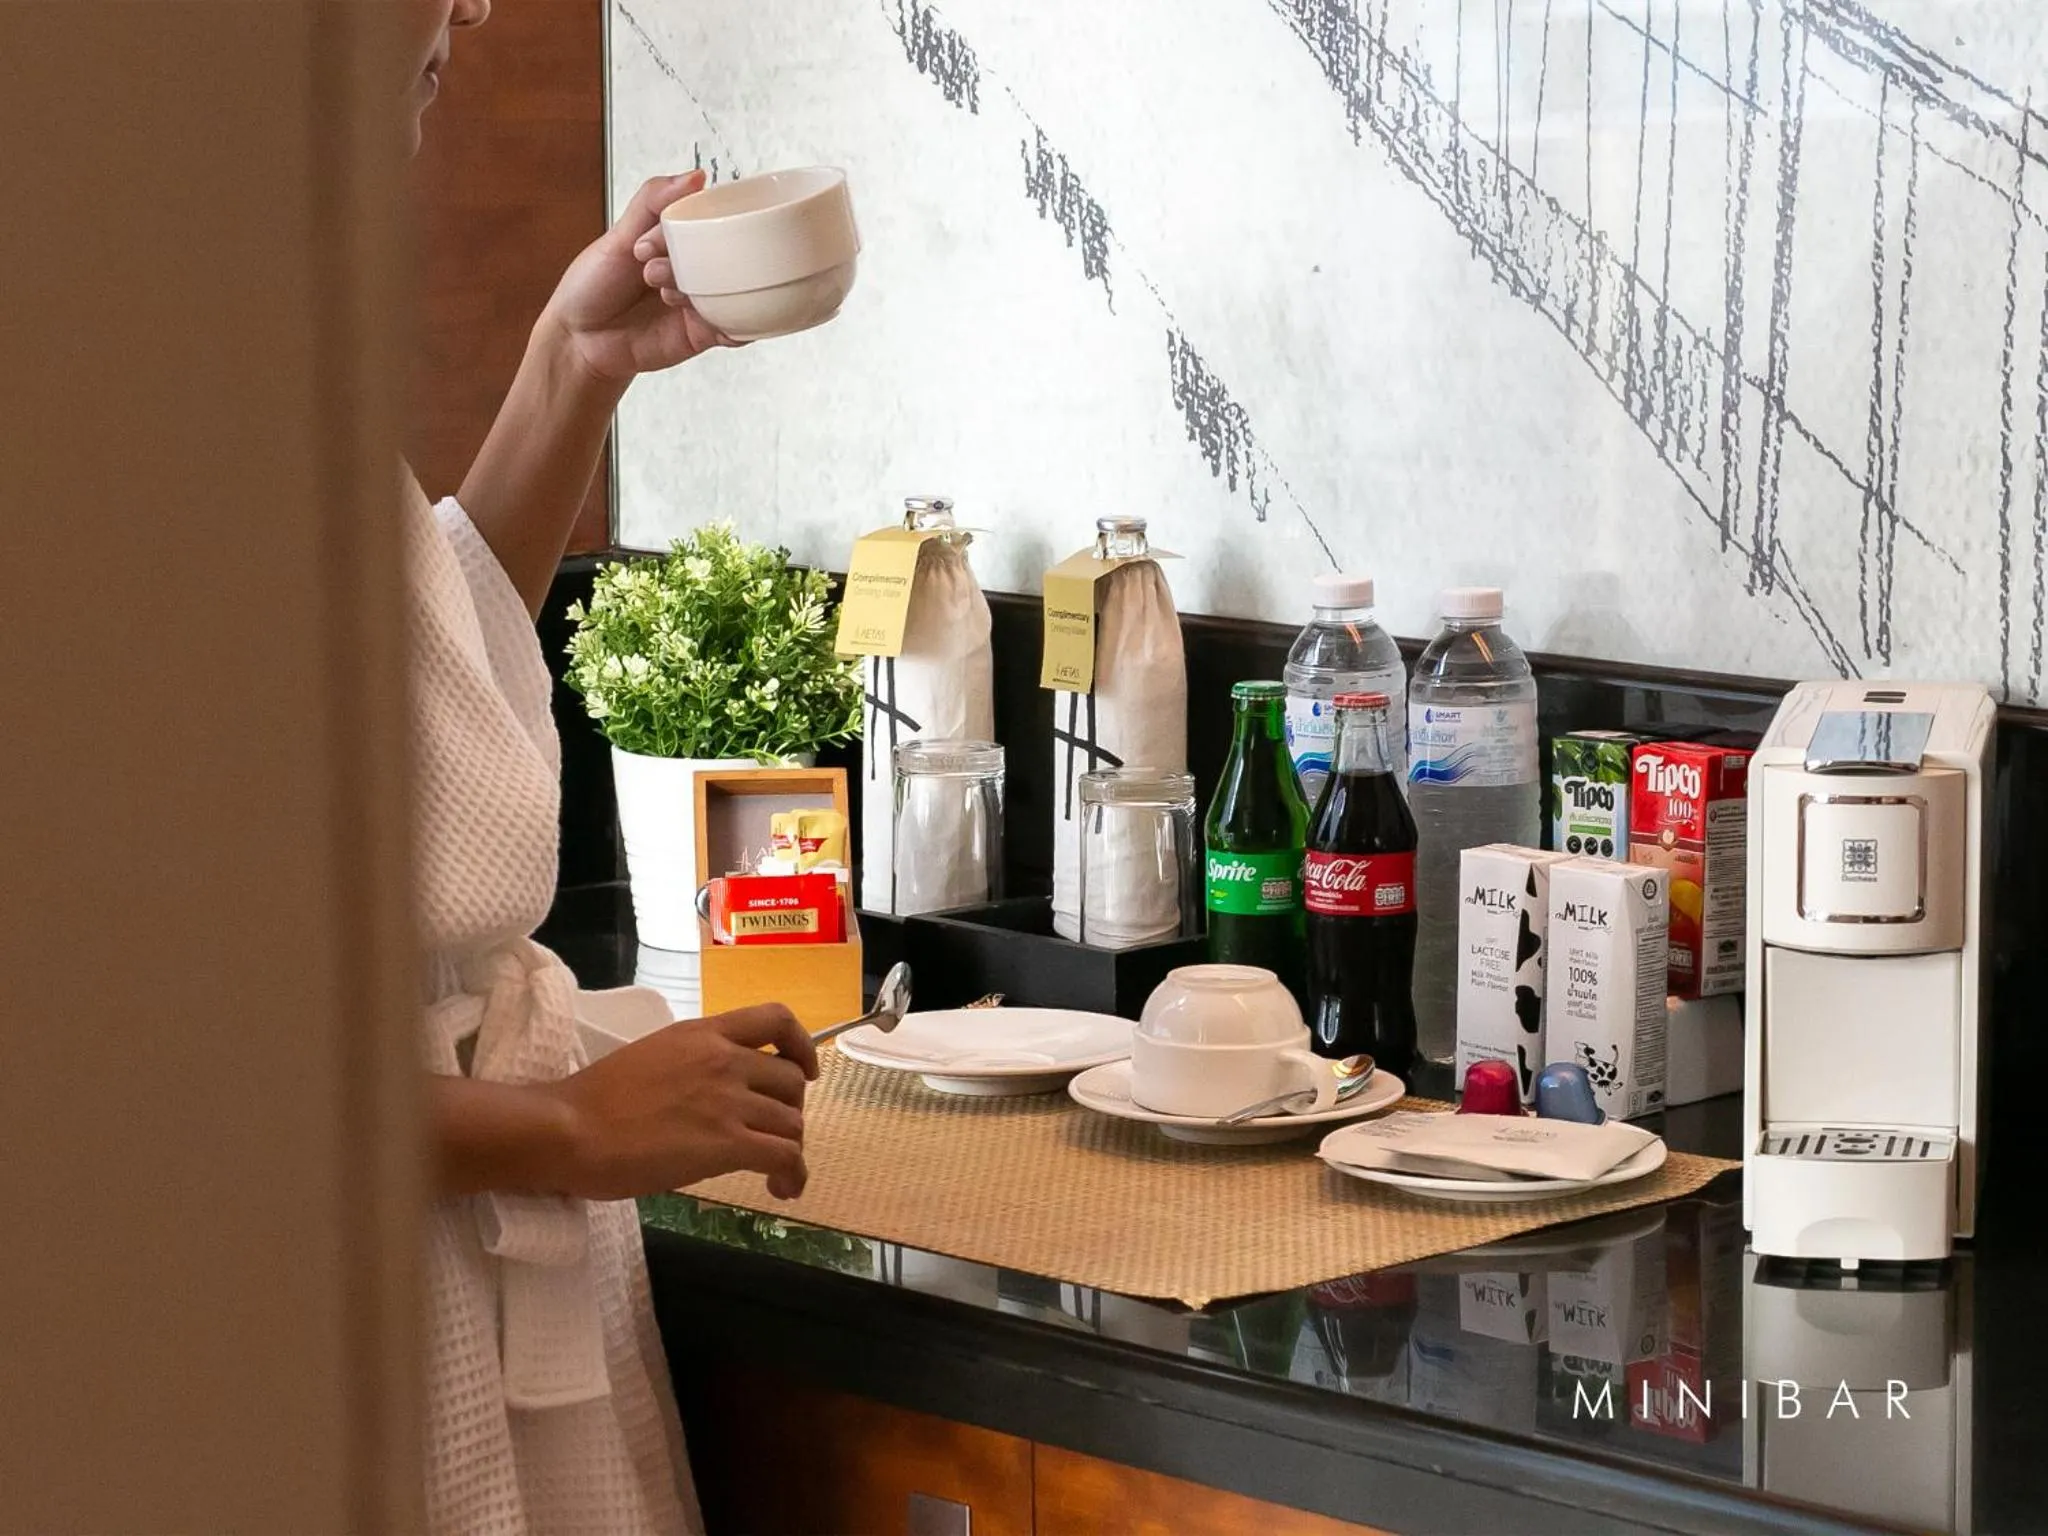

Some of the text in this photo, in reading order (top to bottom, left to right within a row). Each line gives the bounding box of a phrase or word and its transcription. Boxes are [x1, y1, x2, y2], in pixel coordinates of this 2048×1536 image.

[1047, 607, 1090, 623] Complimentary
[1635, 755, 1701, 799] Tipco
[1564, 779, 1615, 811] Tipco
[1208, 857, 1257, 882] Sprite
[1304, 853, 1372, 891] oca-Cola
[741, 914, 809, 929] TWININGS
[1471, 944, 1510, 960] LACTOSE
[1480, 958, 1501, 971] FREE
[1568, 966, 1598, 986] 100%
